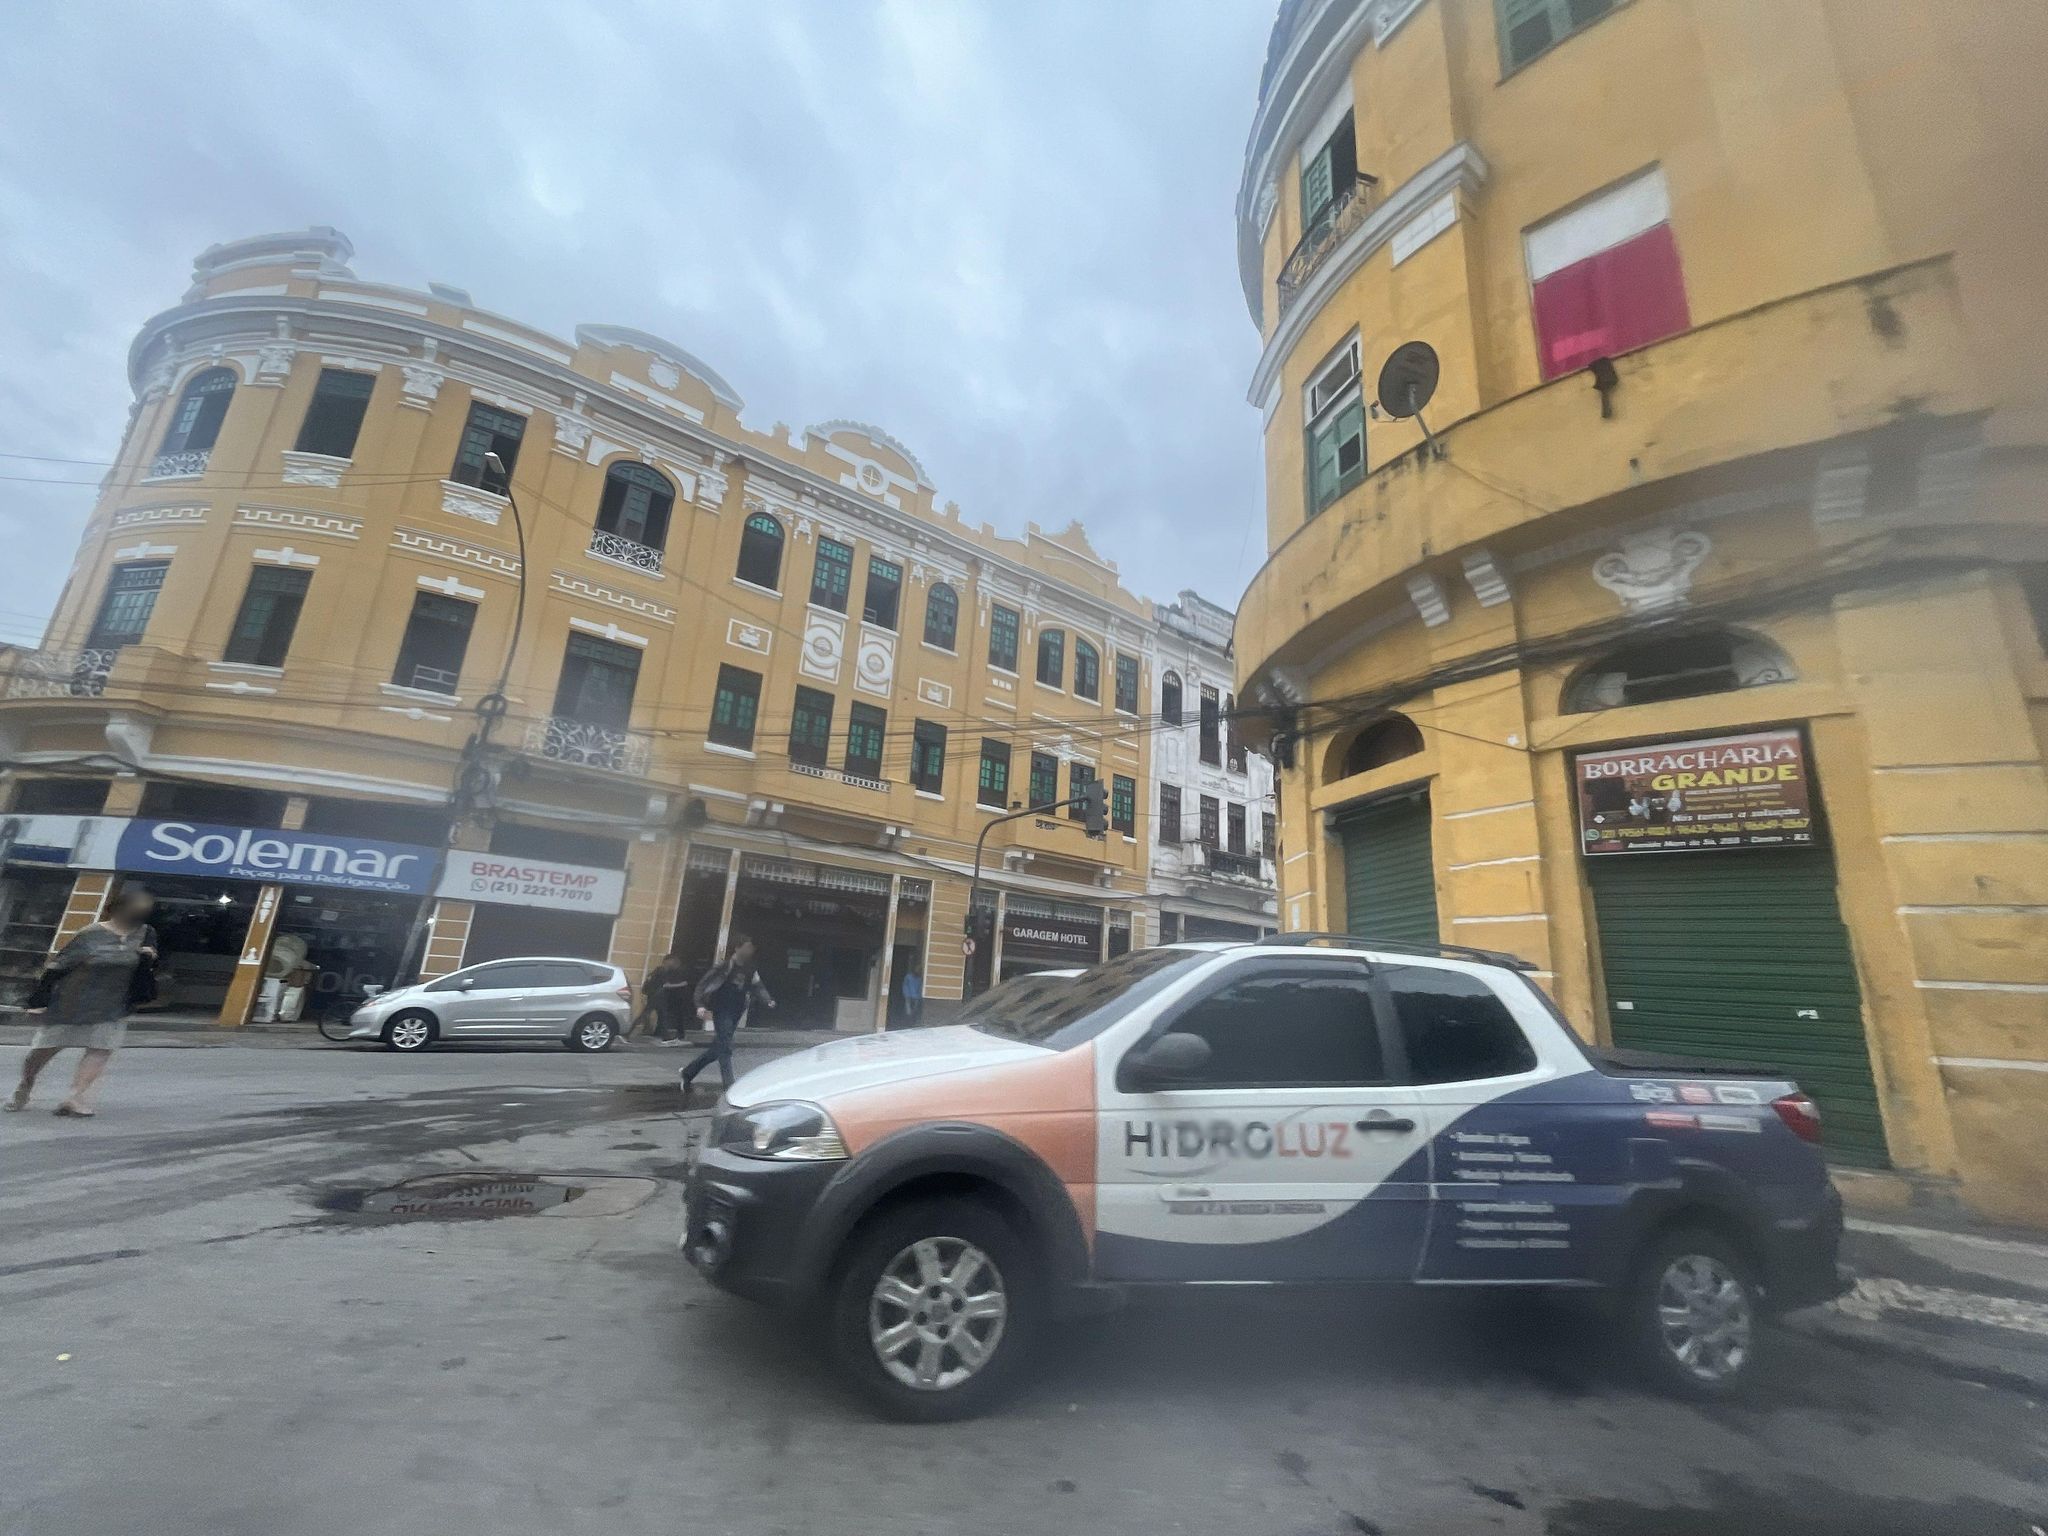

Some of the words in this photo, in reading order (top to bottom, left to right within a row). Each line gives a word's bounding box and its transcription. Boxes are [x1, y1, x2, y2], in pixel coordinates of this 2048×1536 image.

[1584, 744, 1798, 779] BORRACHARIA
[1651, 764, 1799, 791] GRANDE
[145, 822, 419, 879] Solemar
[229, 867, 276, 880] Peças
[279, 872, 312, 883] para
[315, 874, 411, 891] Refrigeração
[470, 861, 598, 888] BRASTEMP
[490, 881, 519, 895] (21)
[1013, 927, 1059, 942] GARAGEM
[1060, 933, 1089, 945] HOTEL
[1125, 1120, 1353, 1159] HIDROLUZ
